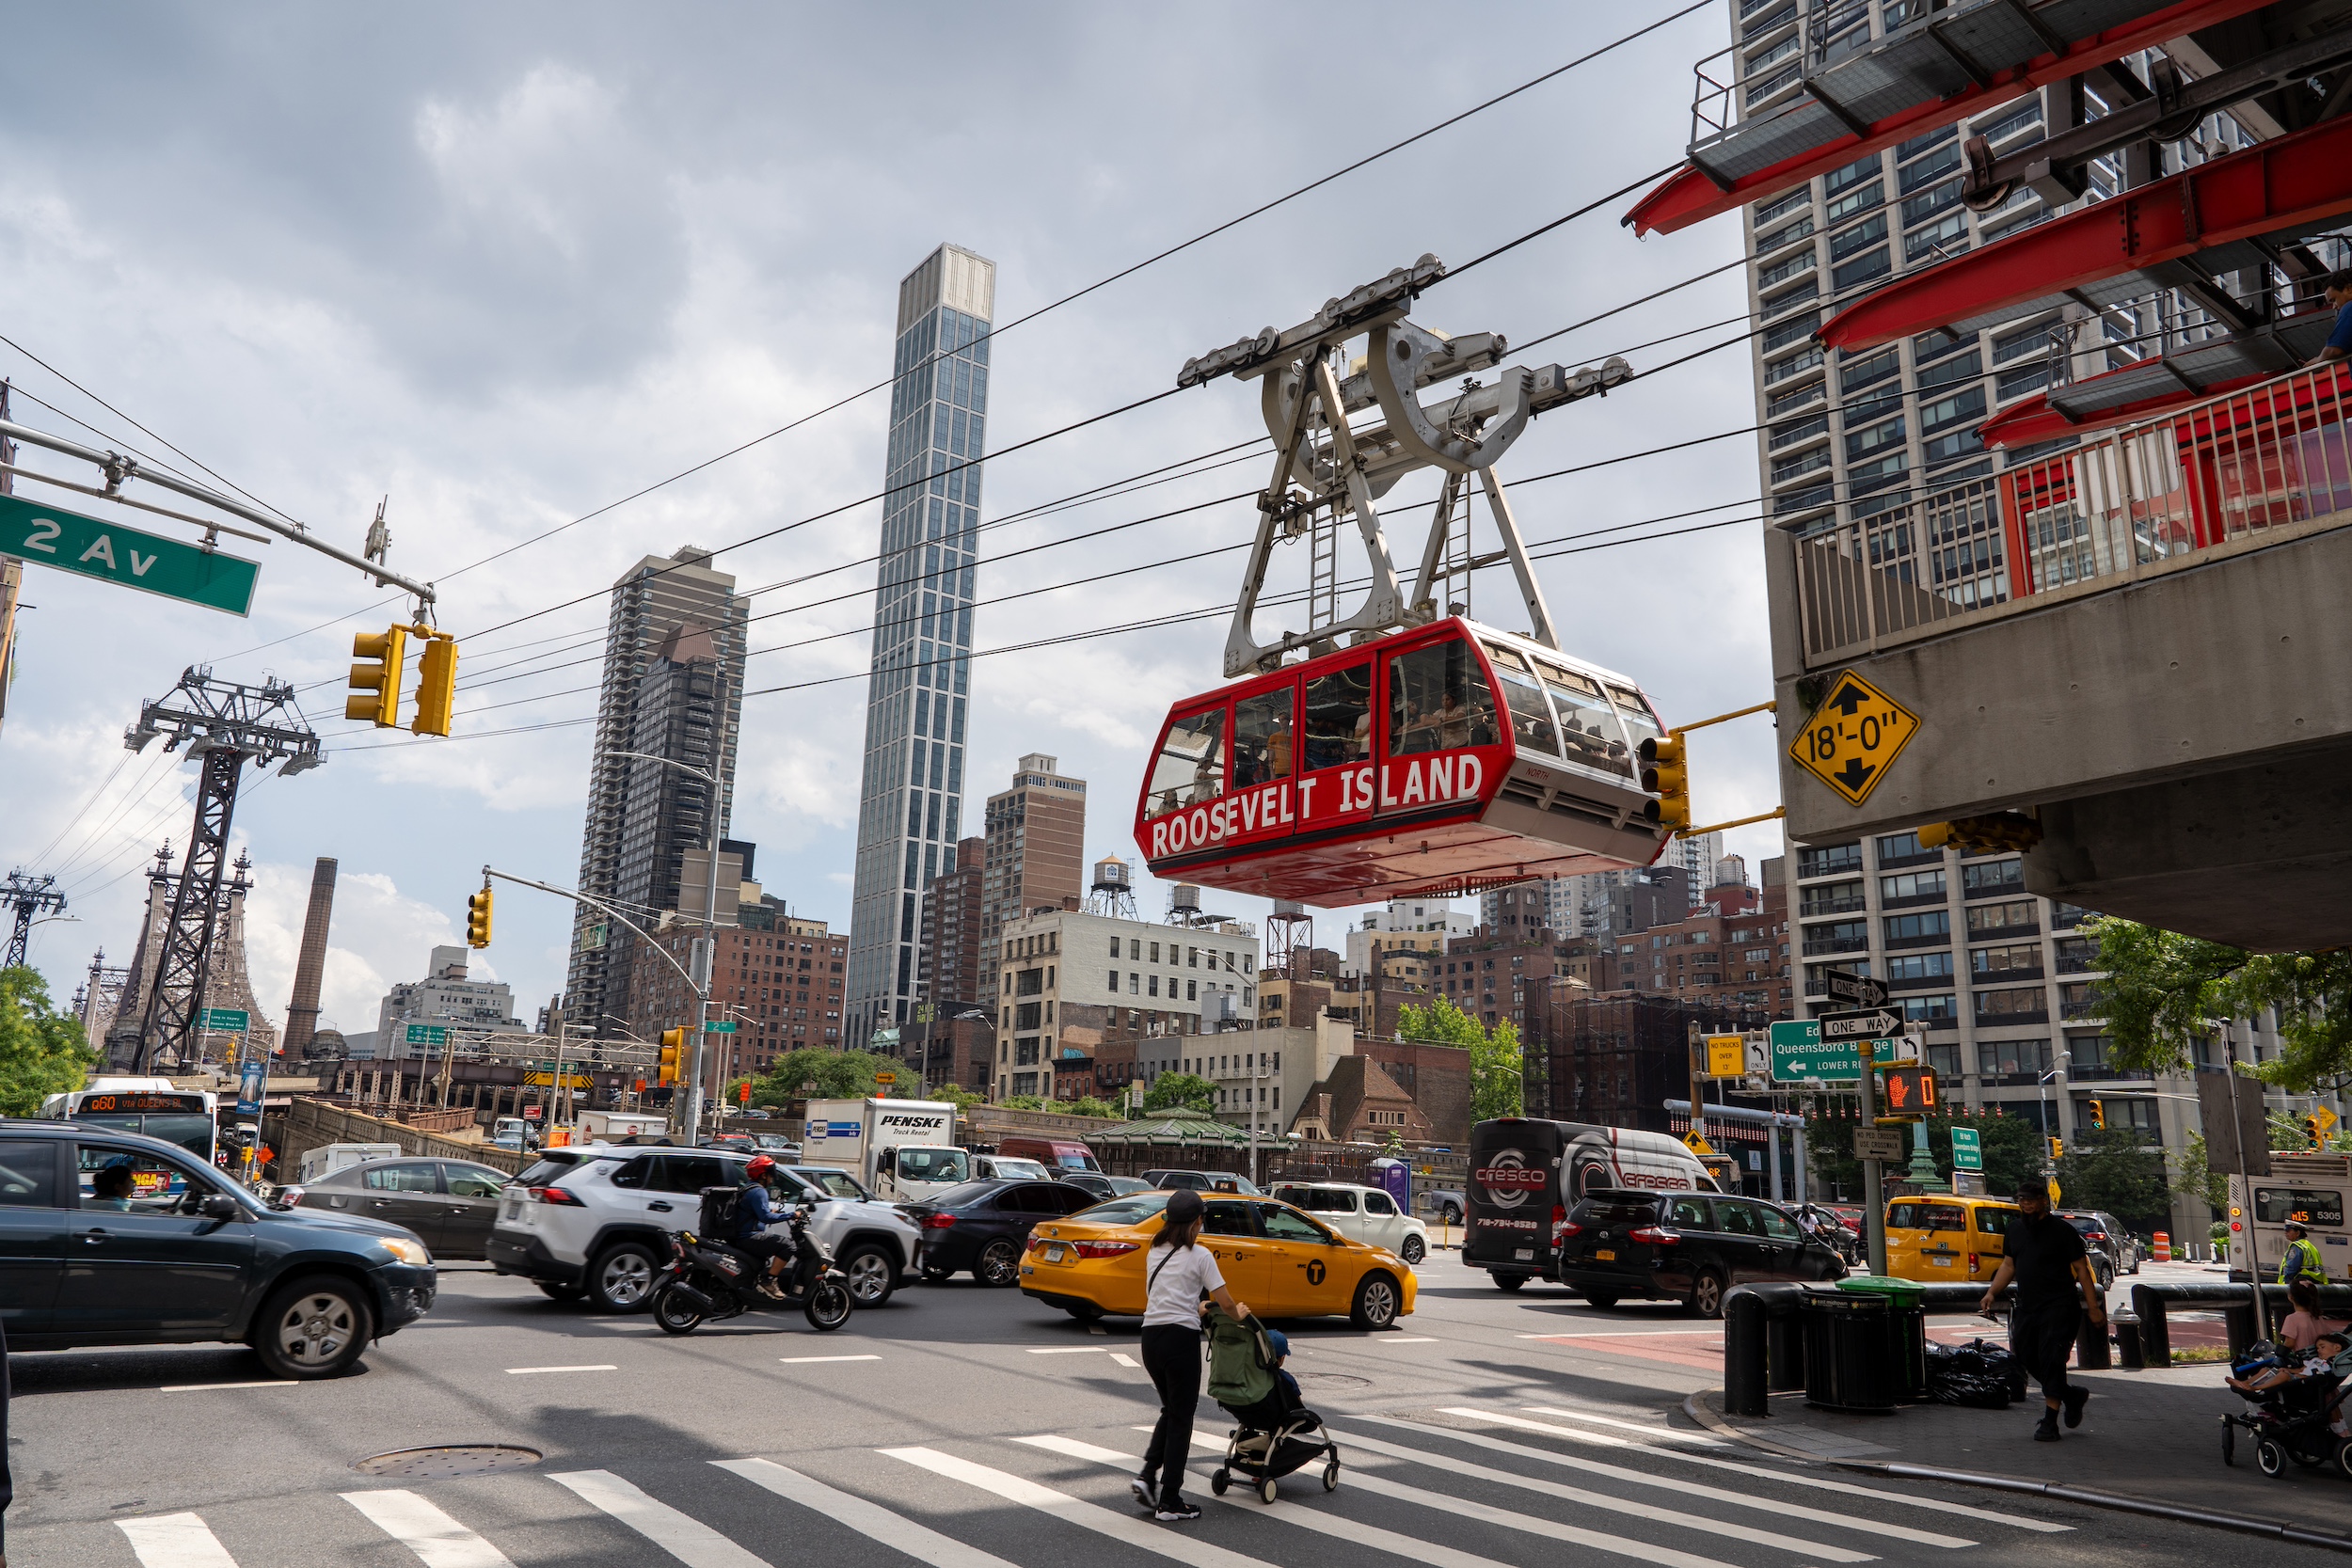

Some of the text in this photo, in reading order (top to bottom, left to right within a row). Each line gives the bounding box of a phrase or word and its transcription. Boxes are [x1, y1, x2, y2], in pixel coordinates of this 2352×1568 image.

[23, 518, 158, 577] 2 Av
[1807, 710, 1898, 763] 18'-0"
[1152, 754, 1483, 858] ROOSEVELT ISLAND
[1836, 980, 1854, 995] ONE
[712, 1022, 720, 1031] 2
[1832, 1017, 1891, 1034] ONE WAY
[1776, 1043, 1845, 1054] Queensboro
[1817, 1061, 1849, 1070] LOWER
[91, 1096, 183, 1111] Q60 VIA QUEENS BL
[881, 1116, 945, 1129] PENSKE
[812, 1125, 826, 1133] PENSKE
[1877, 1132, 1900, 1141] CROSSING
[2291, 1211, 2310, 1222] M15
[2316, 1211, 2342, 1221] 5305
[1476, 1218, 1538, 1229] 718-734-8528
[1311, 1263, 1322, 1283] T
